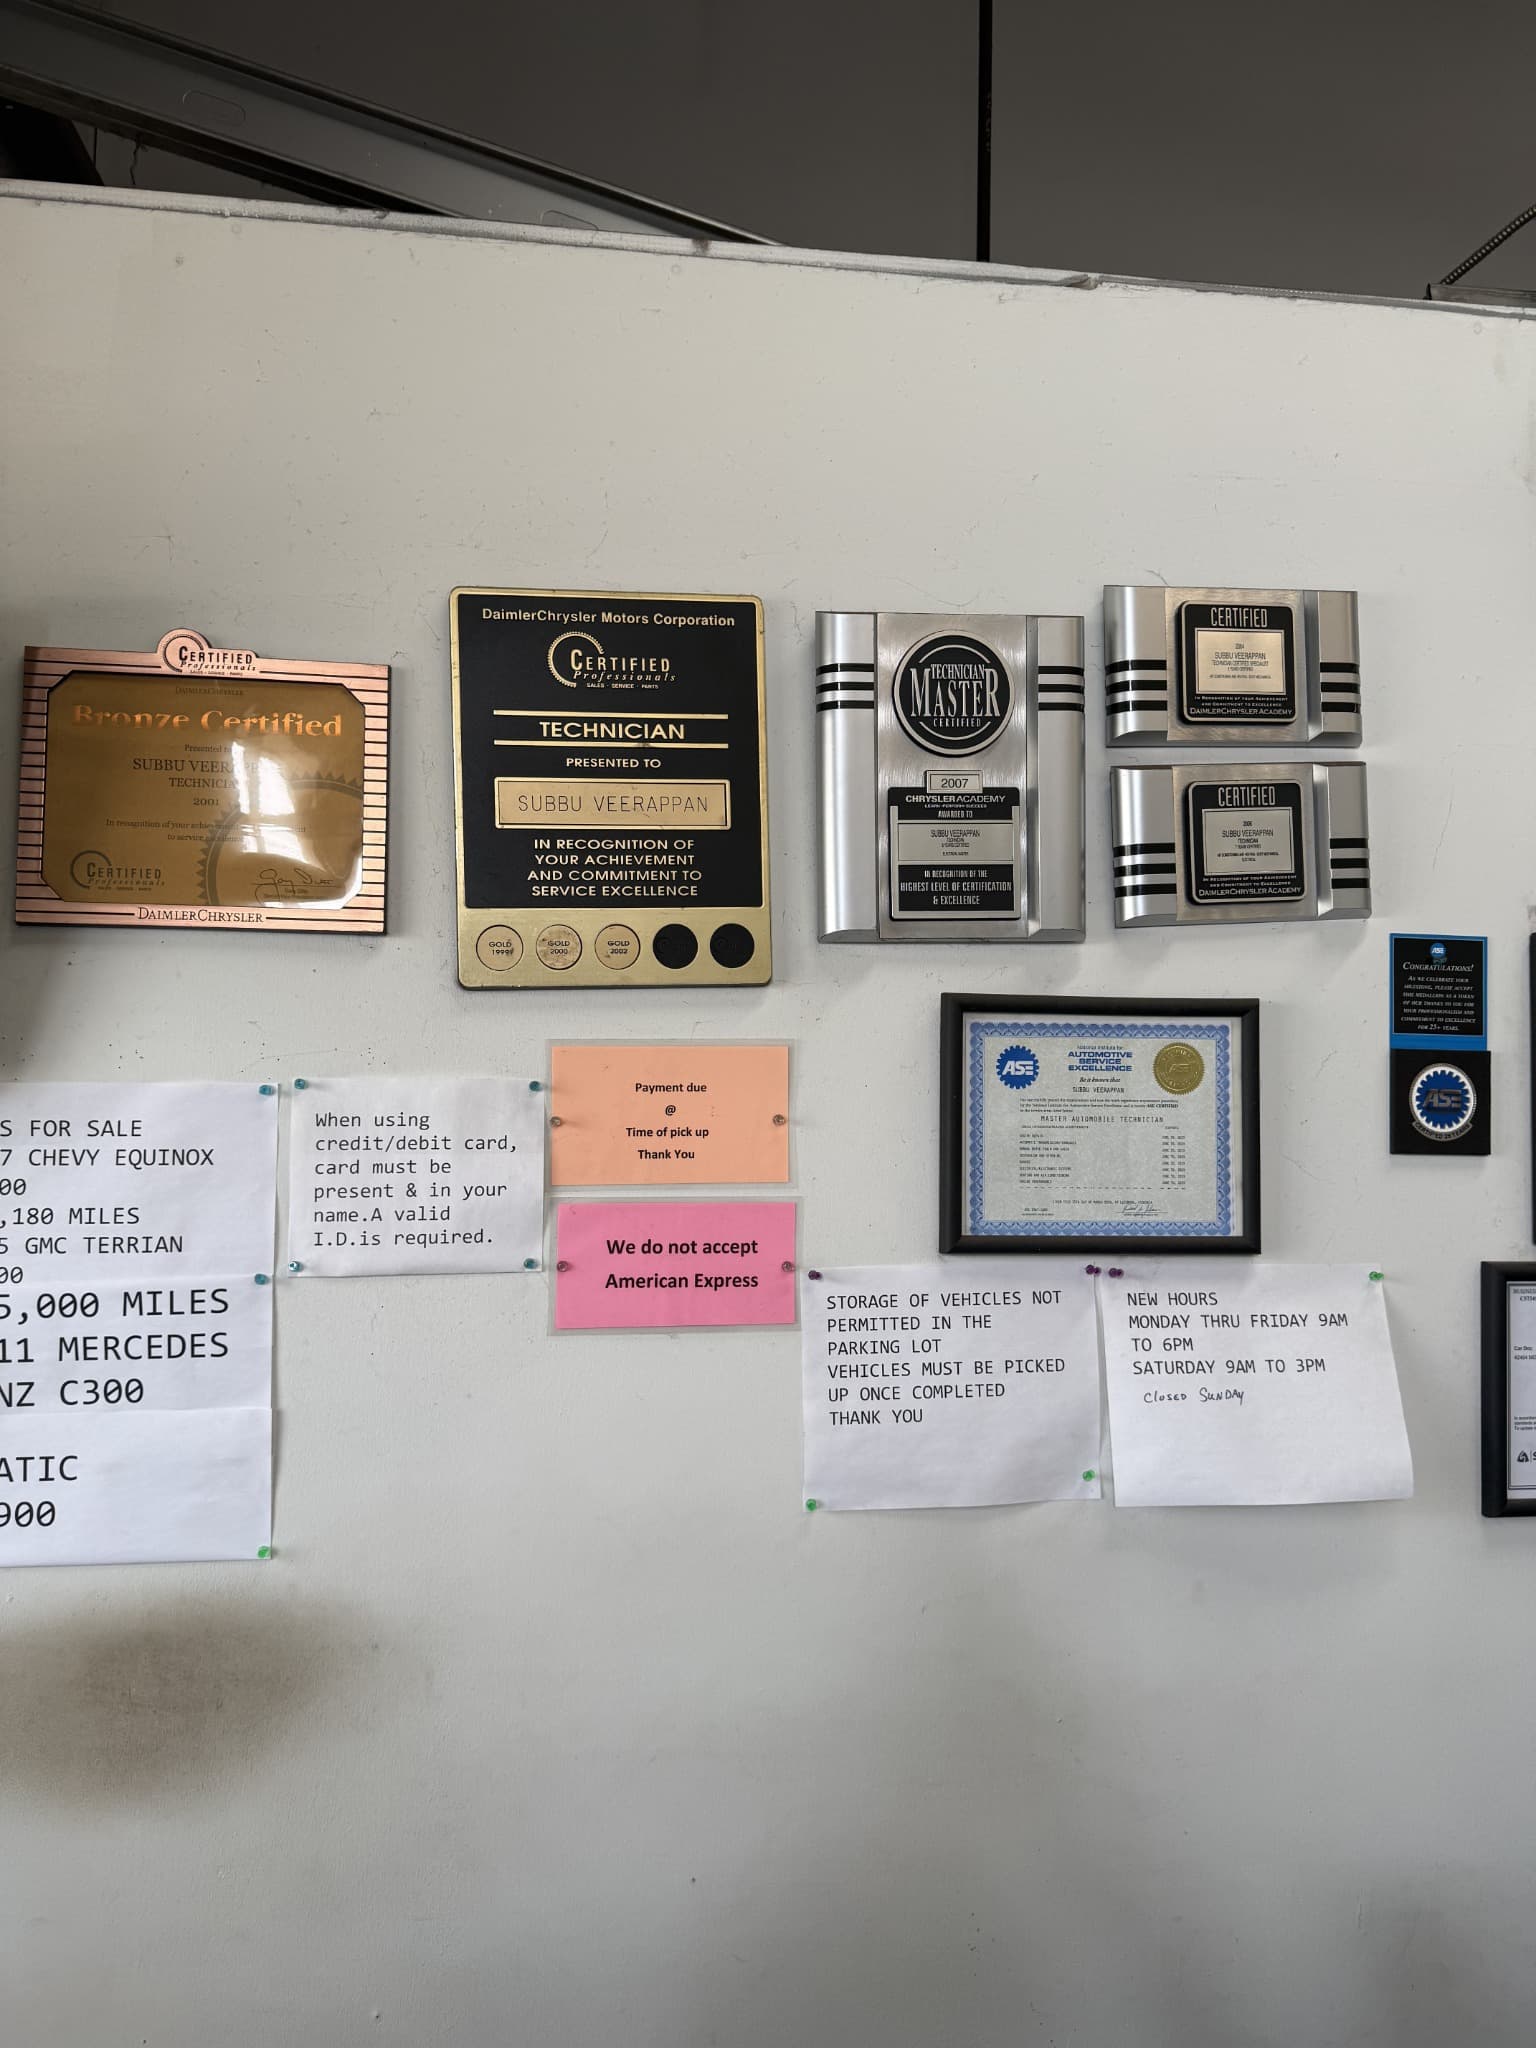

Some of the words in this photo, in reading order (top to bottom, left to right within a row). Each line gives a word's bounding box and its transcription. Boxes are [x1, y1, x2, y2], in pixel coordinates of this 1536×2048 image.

[482, 608, 597, 625] DaimlerChrysler
[600, 611, 649, 626] Motors
[653, 613, 736, 628] Corporation
[1210, 607, 1268, 628] CERTIFIED
[178, 646, 253, 665] CERTIFIED
[570, 649, 670, 672] CERTIFIED
[573, 671, 677, 682] Professionals
[931, 663, 985, 680] TECHNICIAN
[910, 668, 1001, 717] MASTER
[71, 704, 190, 730] Bronze
[200, 710, 342, 738] Certified
[1259, 708, 1293, 716] ACADEMY
[539, 721, 685, 741] TECHNICIAN
[934, 717, 982, 728] CERTIFIED
[133, 758, 186, 772] SUBBU
[566, 757, 640, 769] PRESENTED
[644, 758, 662, 769] TO
[941, 778, 969, 789] 2007
[518, 795, 583, 812] SUBBU
[594, 796, 709, 813] VEERAPPAN
[905, 795, 956, 803] CHRYSLER
[956, 795, 1006, 803] ACADEMY
[1218, 786, 1276, 807] CERTIFIED
[533, 839, 550, 850] IN
[557, 839, 668, 850] RECOGNITION
[674, 839, 695, 850] OF
[534, 854, 579, 866] YOUR
[584, 854, 695, 866] ACHIEVEMENT
[87, 862, 161, 879] CERTIFIED
[527, 870, 563, 881] AND
[569, 870, 678, 881] COMMITMENT
[682, 870, 702, 881] TO
[532, 885, 597, 897] SERVICE
[602, 885, 699, 897] EXCELLENCE
[900, 881, 929, 892] HIGHEST
[931, 881, 950, 892] LEVEL
[952, 881, 960, 892] OF
[962, 881, 1012, 892] CERTIFICATION
[940, 895, 981, 905] EXCELLENCE
[138, 905, 264, 923] DAIMLERCHRYSLER
[1003, 1060, 1034, 1075] ASE
[635, 1082, 684, 1094] Payment
[687, 1082, 707, 1093] due
[1423, 1088, 1461, 1108] ASE
[665, 1105, 676, 1116] @
[30, 1119, 71, 1137] FOR
[87, 1119, 143, 1137] SALE
[315, 1112, 361, 1128] When
[374, 1112, 430, 1130] using
[626, 1126, 653, 1137] Time
[656, 1126, 668, 1137] of
[670, 1126, 693, 1139] pick
[695, 1128, 709, 1139] up
[316, 1135, 451, 1153] credit/debit
[464, 1135, 517, 1153] card,
[1, 1149, 12, 1166] 7
[28, 1149, 100, 1166] CHEVY
[116, 1148, 214, 1170] EQUINOX
[637, 1149, 671, 1160] Thank
[674, 1149, 695, 1160] You
[315, 1159, 360, 1175] card
[373, 1160, 417, 1175] must
[430, 1158, 451, 1174] be
[314, 1183, 394, 1202] present
[406, 1183, 417, 1198] &
[430, 1182, 451, 1197] in
[463, 1183, 507, 1201] your
[69, 1207, 140, 1225] MILES
[314, 1207, 383, 1222] name.A
[394, 1206, 451, 1222] valid
[25, 1237, 67, 1254] GMC
[83, 1236, 183, 1254] TERRIAN
[314, 1231, 381, 1246] I.D.is
[394, 1228, 493, 1248] required.
[606, 1239, 636, 1255] We
[641, 1239, 663, 1255] do
[668, 1240, 697, 1255] not
[702, 1240, 758, 1258] accept
[605, 1273, 689, 1289] American
[694, 1273, 759, 1291] Express
[0, 1292, 100, 1325] 5,000
[123, 1288, 229, 1316] MILES
[827, 1294, 898, 1310] STORAGE
[909, 1293, 929, 1308] OF
[941, 1291, 1022, 1307] VEHICLES
[1032, 1290, 1062, 1305] NOT
[1127, 1292, 1158, 1306] NEW
[1168, 1292, 1218, 1306] HOURS
[827, 1316, 920, 1332] PERMITTED
[932, 1316, 951, 1330] IN
[962, 1314, 992, 1329] THE
[1129, 1315, 1190, 1329] MONDAY
[1200, 1314, 1240, 1328] THRU
[1250, 1313, 1308, 1328] FRIDAY
[1318, 1313, 1348, 1327] 9AM
[58, 1332, 229, 1362] MERCEDES
[828, 1339, 900, 1356] PARKING
[912, 1339, 942, 1354] LOT
[1131, 1337, 1152, 1351] TO
[1163, 1337, 1194, 1351] 6PM
[827, 1362, 911, 1379] VEHICLES
[921, 1361, 962, 1376] MUST
[974, 1360, 993, 1375] BE
[1005, 1358, 1065, 1374] PICKED
[1133, 1360, 1215, 1375] SATURDAY
[1226, 1359, 1256, 1374] 9AM
[1265, 1359, 1286, 1373] TO
[1296, 1358, 1326, 1373] 3PM
[60, 1378, 144, 1406] C300
[828, 1388, 848, 1402] UP
[860, 1386, 901, 1401] ONCE
[912, 1383, 1006, 1400] COMPLETED
[830, 1410, 881, 1426] THANK
[892, 1408, 923, 1423] YOU
